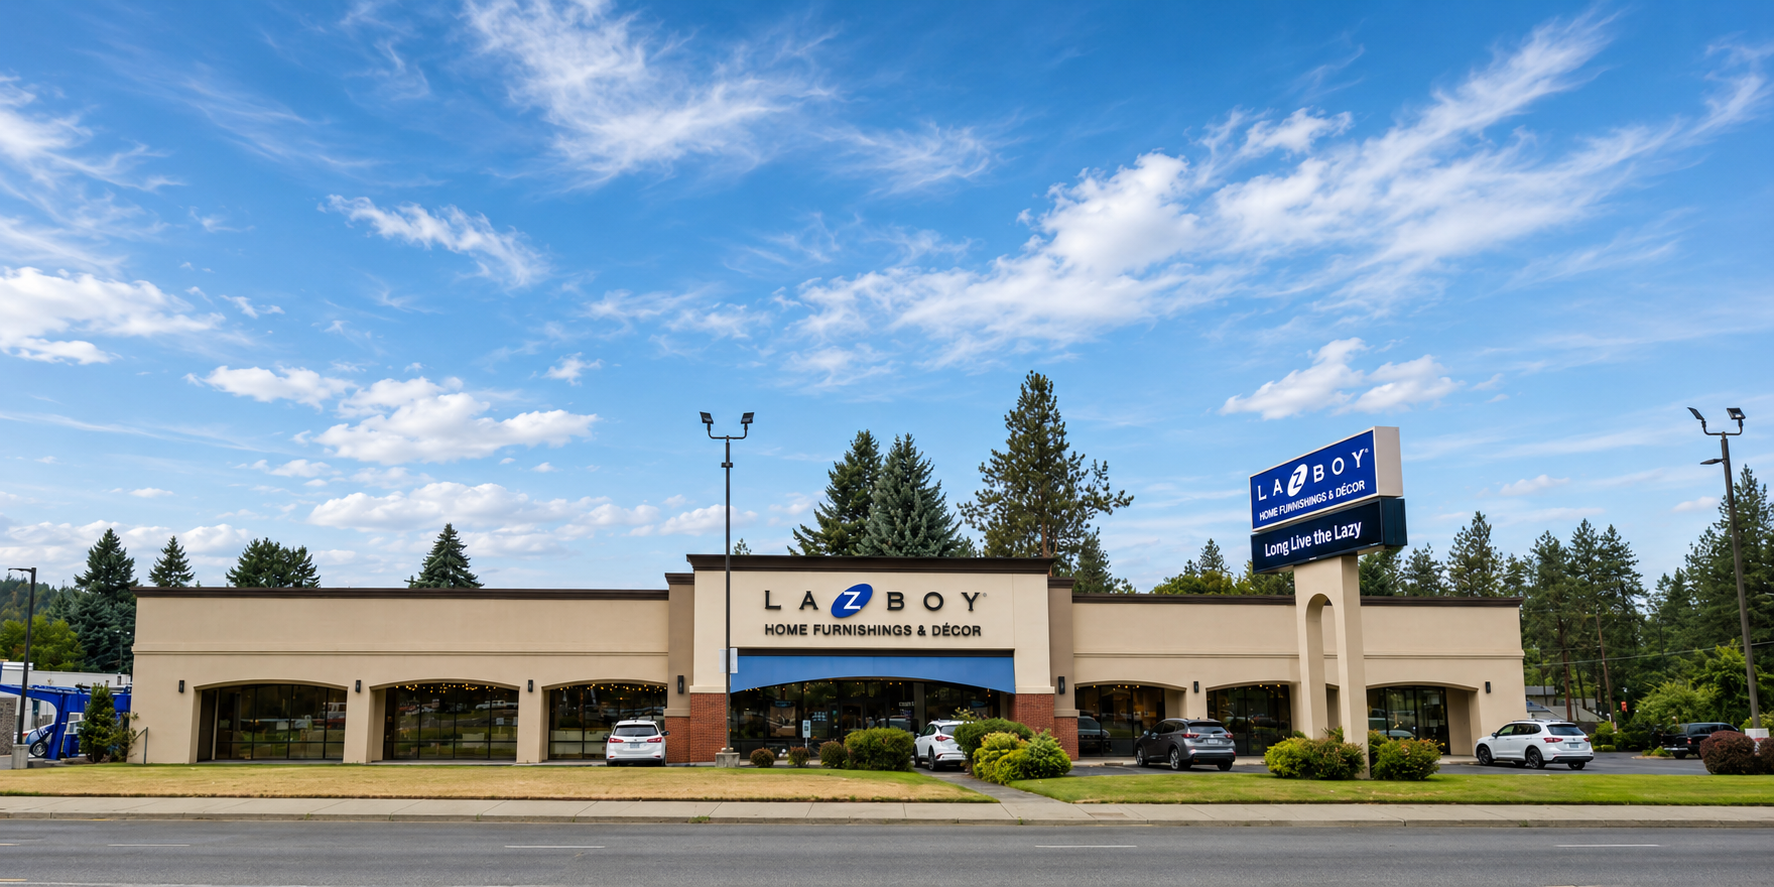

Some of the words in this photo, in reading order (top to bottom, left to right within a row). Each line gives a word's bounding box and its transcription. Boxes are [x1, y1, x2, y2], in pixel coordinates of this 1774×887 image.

[1259, 507, 1278, 521] HOME
[1328, 490, 1334, 500] &
[1335, 480, 1365, 498] DÉCOR
[1265, 541, 1289, 557] Long
[1290, 534, 1312, 551] Live
[1313, 528, 1332, 545] the
[1334, 521, 1362, 540] Lazy
[764, 623, 808, 636] HOME
[813, 624, 912, 637] FURNISHINGS
[917, 625, 927, 637] &
[931, 622, 982, 637] DÉCOR
